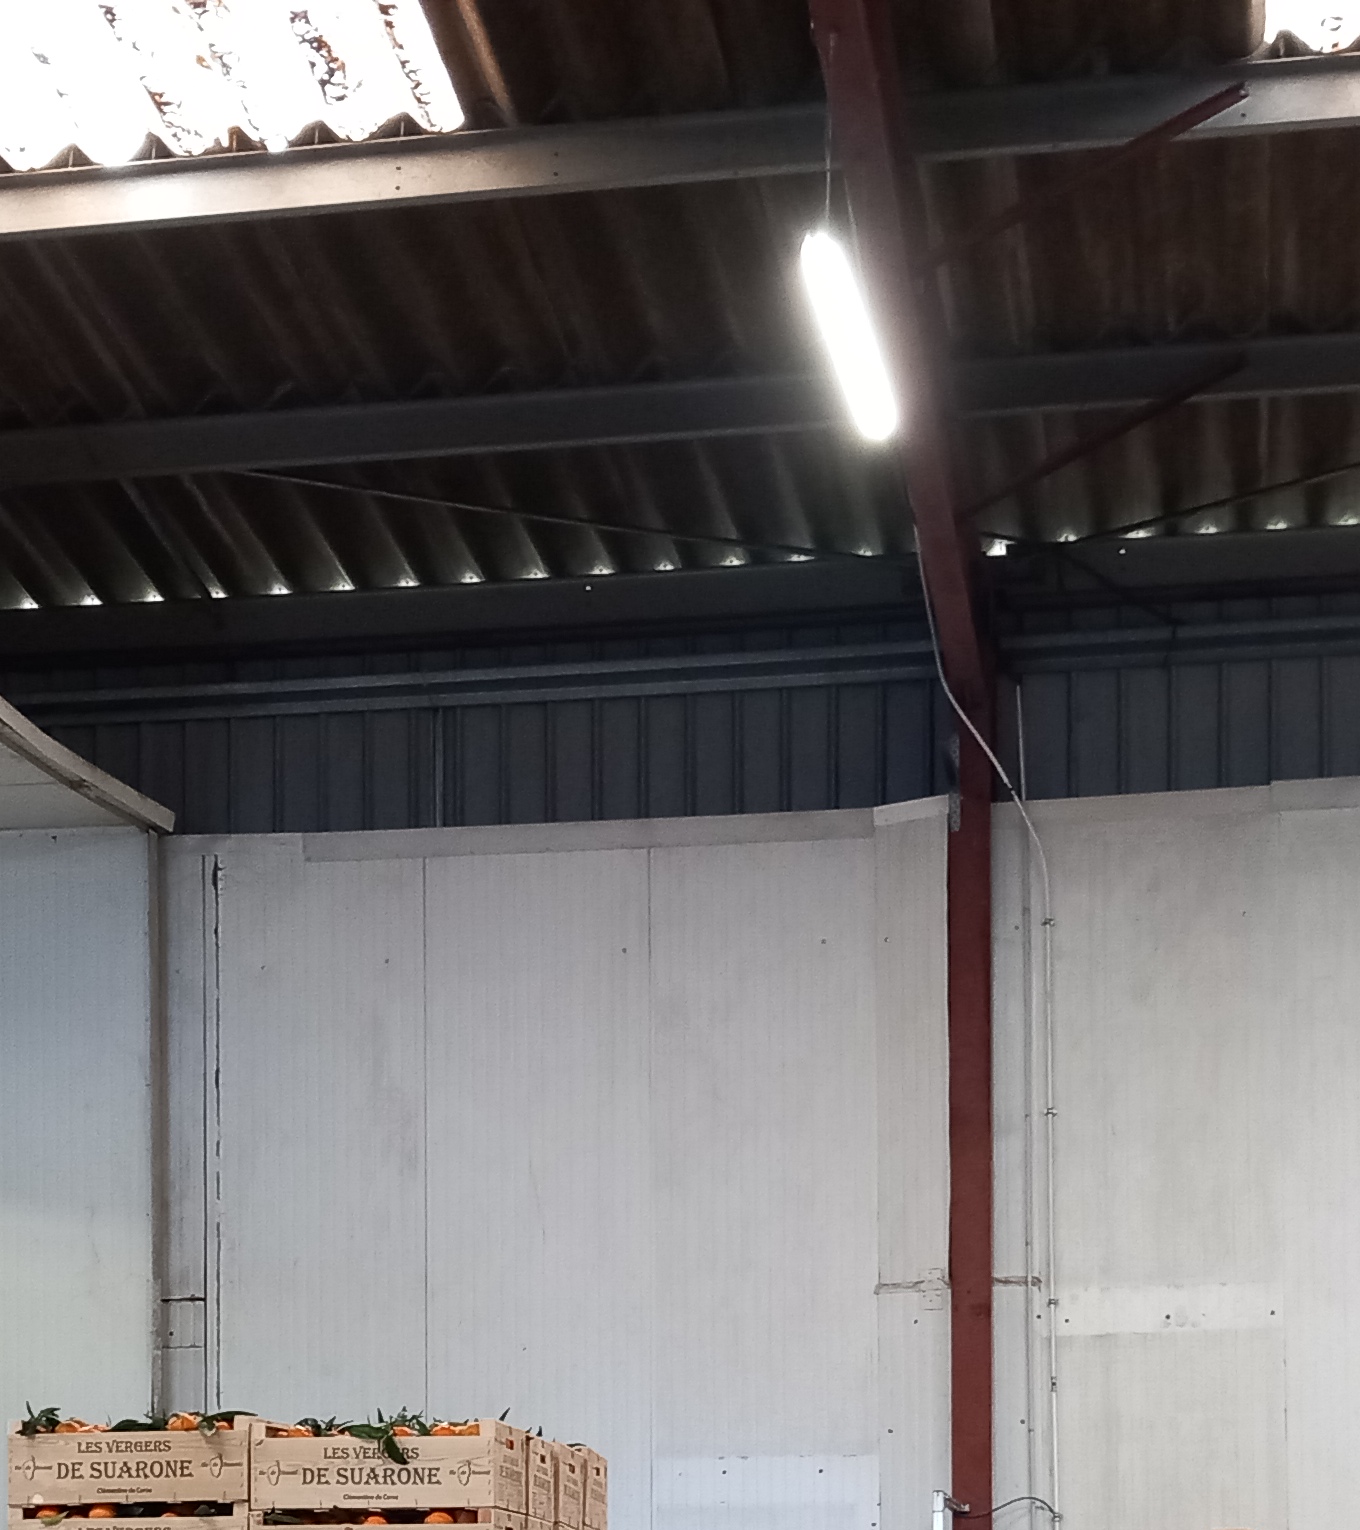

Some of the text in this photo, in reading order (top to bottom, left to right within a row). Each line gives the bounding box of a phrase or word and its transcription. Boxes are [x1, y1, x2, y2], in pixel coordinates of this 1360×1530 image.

[77, 1440, 171, 1453] LES VERGERS
[57, 1460, 194, 1479] DE SUARONE
[302, 1468, 441, 1485] DE SUARONE
